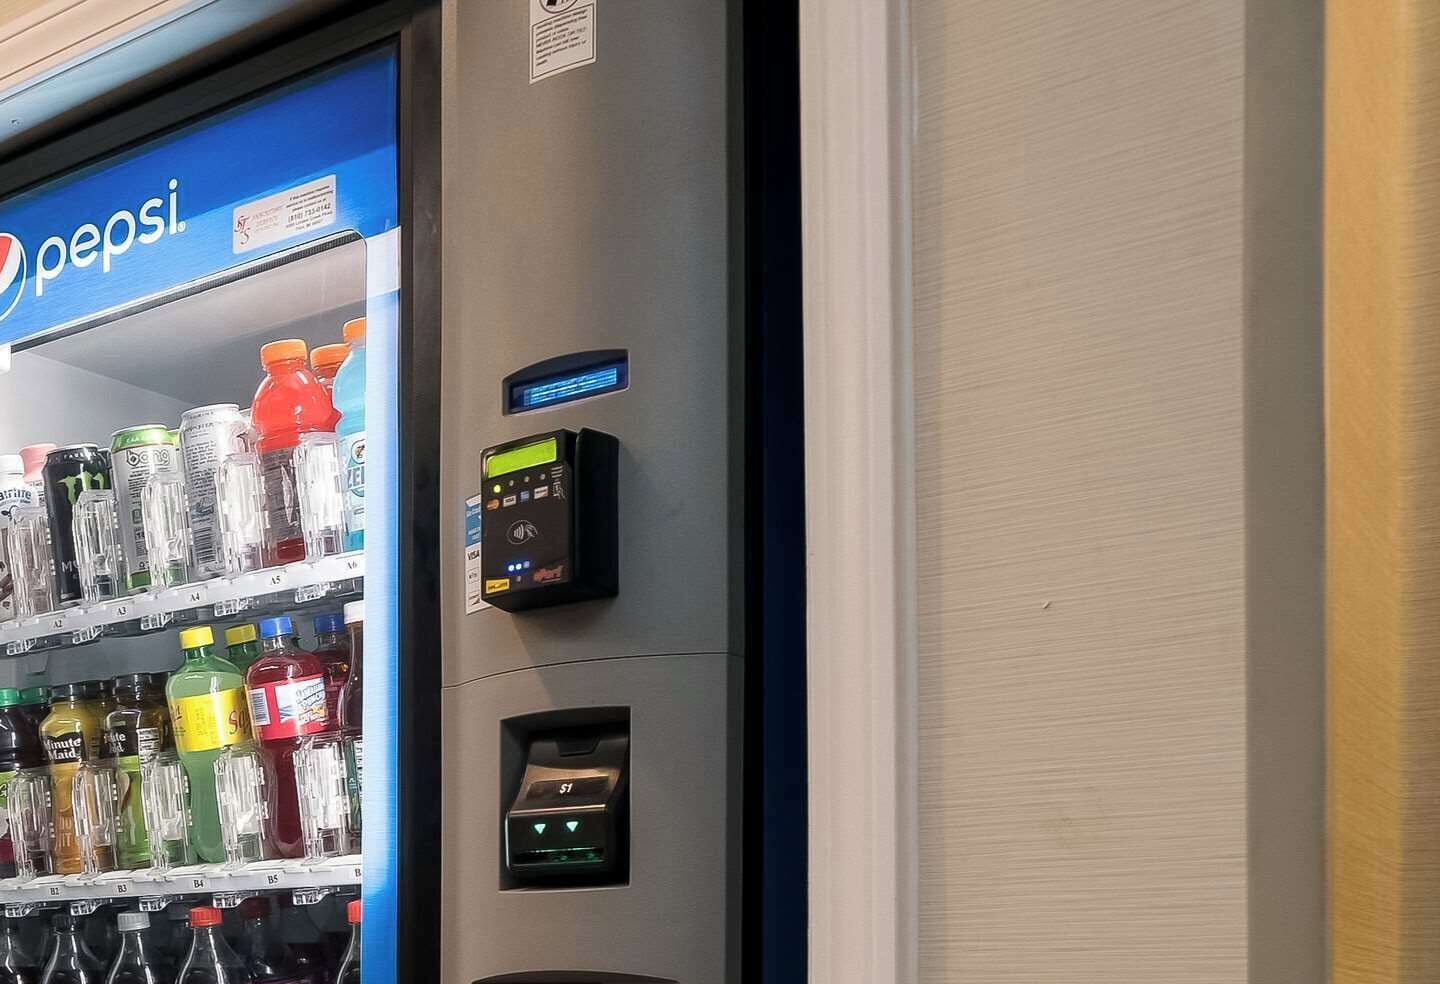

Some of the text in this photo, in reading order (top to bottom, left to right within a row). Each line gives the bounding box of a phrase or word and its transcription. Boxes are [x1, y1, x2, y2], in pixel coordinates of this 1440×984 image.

[35, 178, 179, 296] pepsi
[116, 606, 127, 616] A3
[44, 737, 81, 751] Minute
[47, 747, 80, 760] Maid
[560, 783, 573, 794] S1
[355, 867, 362, 877] B
[193, 878, 204, 888] B4
[268, 874, 279, 884] B5
[117, 884, 128, 893] B3
